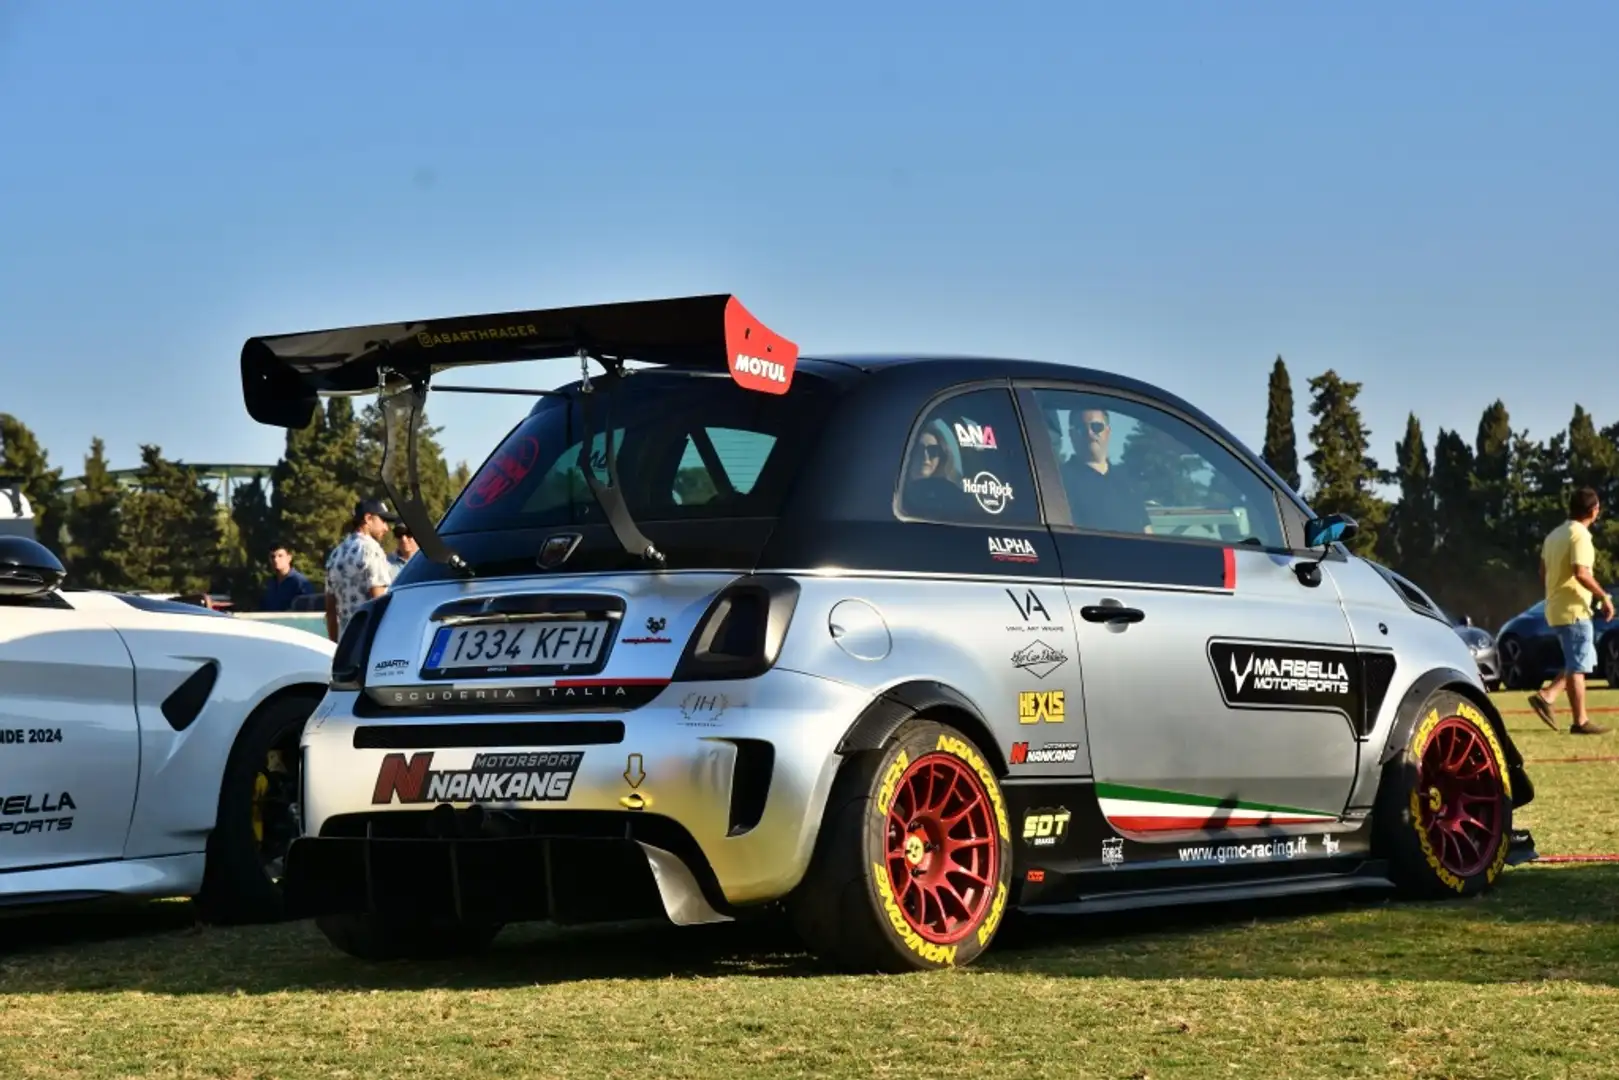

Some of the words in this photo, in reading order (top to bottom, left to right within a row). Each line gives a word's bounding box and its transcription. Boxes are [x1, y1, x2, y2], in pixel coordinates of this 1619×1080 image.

[735, 353, 786, 383] MOTUL
[962, 478, 988, 495] Hard
[989, 481, 1014, 500] Rock
[988, 536, 1036, 554] ALPHA
[453, 629, 525, 662] 1334
[532, 627, 599, 659] KFH
[1254, 658, 1349, 680] MARBELLA
[394, 690, 516, 702] SCUDERIA
[536, 687, 627, 697] ITALIA
[1254, 677, 1349, 694] MOTORSPORTS
[1019, 690, 1065, 725] HEXIS
[28, 729, 63, 743] 2024
[474, 754, 579, 769] MOTORSPORT
[427, 772, 573, 800] NANKANG
[0, 792, 76, 816] ELLA
[1023, 814, 1070, 838] SDT
[1178, 836, 1307, 863] www.gmc-racing.it
